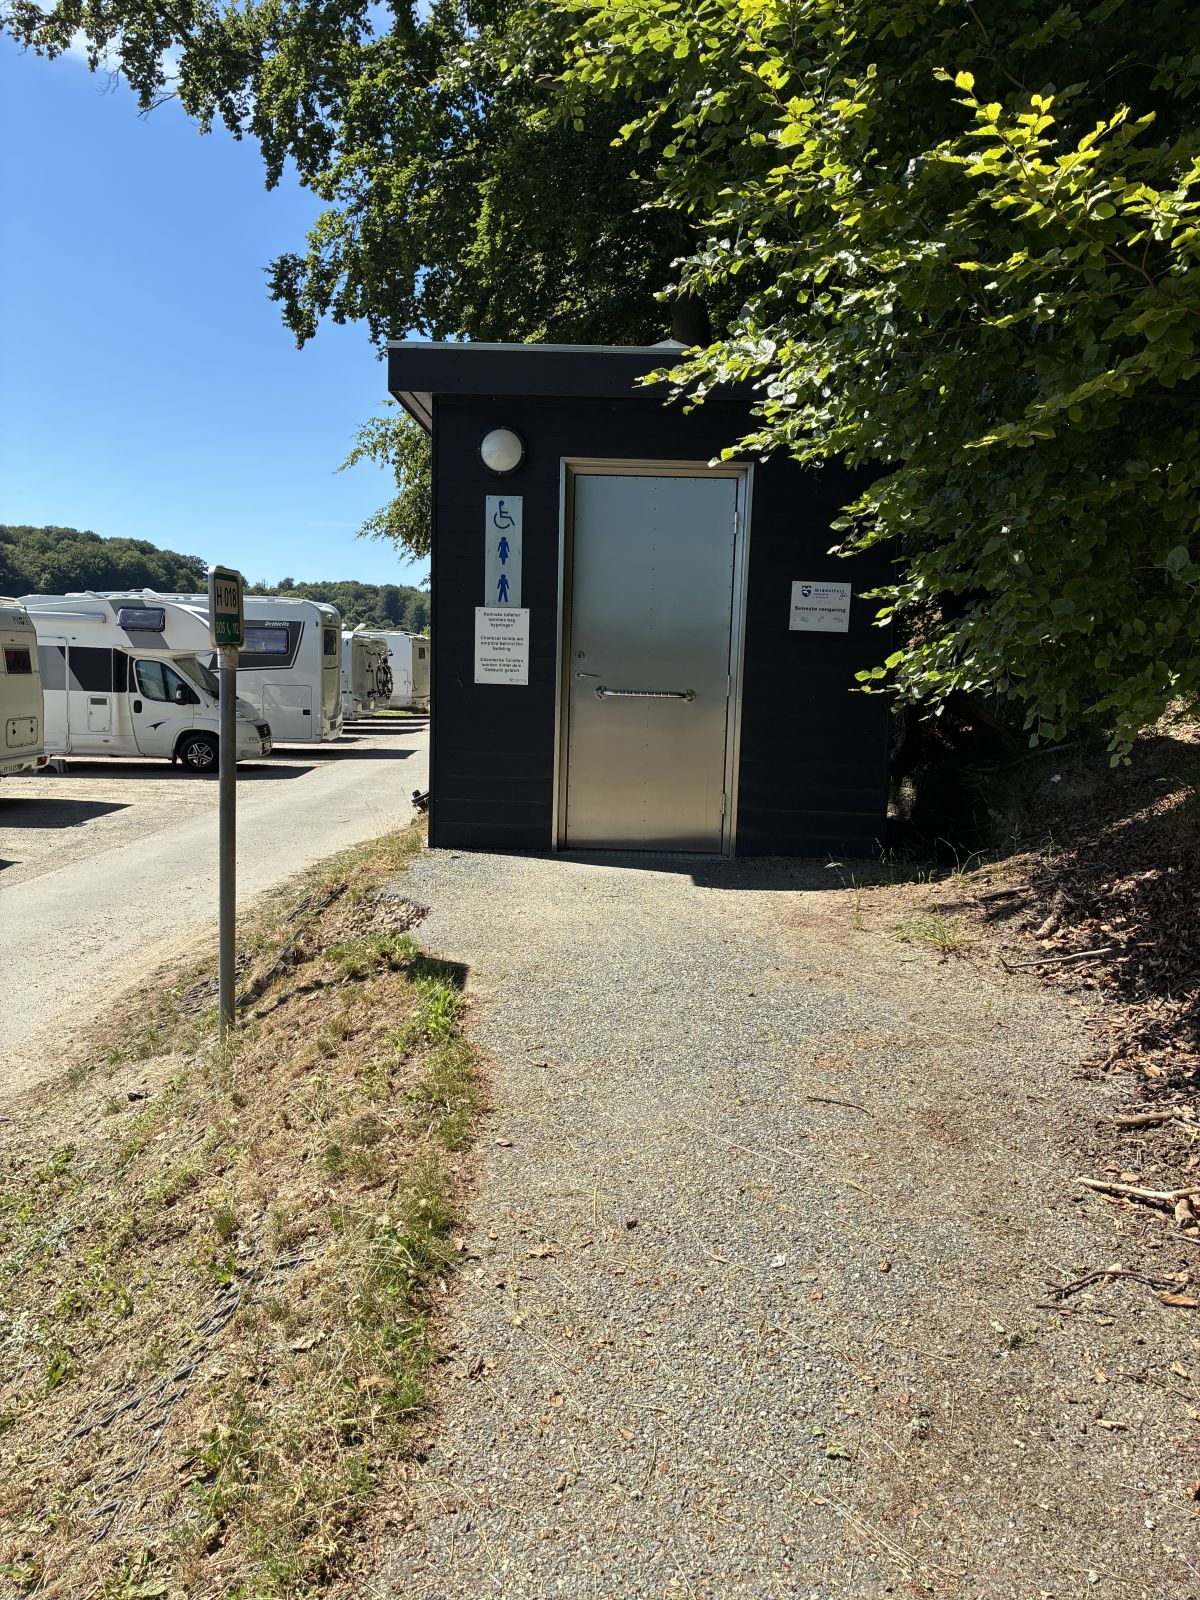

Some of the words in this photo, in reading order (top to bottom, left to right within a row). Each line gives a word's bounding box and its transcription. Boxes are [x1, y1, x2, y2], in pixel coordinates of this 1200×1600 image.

[217, 586, 222, 606] H
[225, 588, 237, 608] 018
[216, 622, 225, 634] SOS
